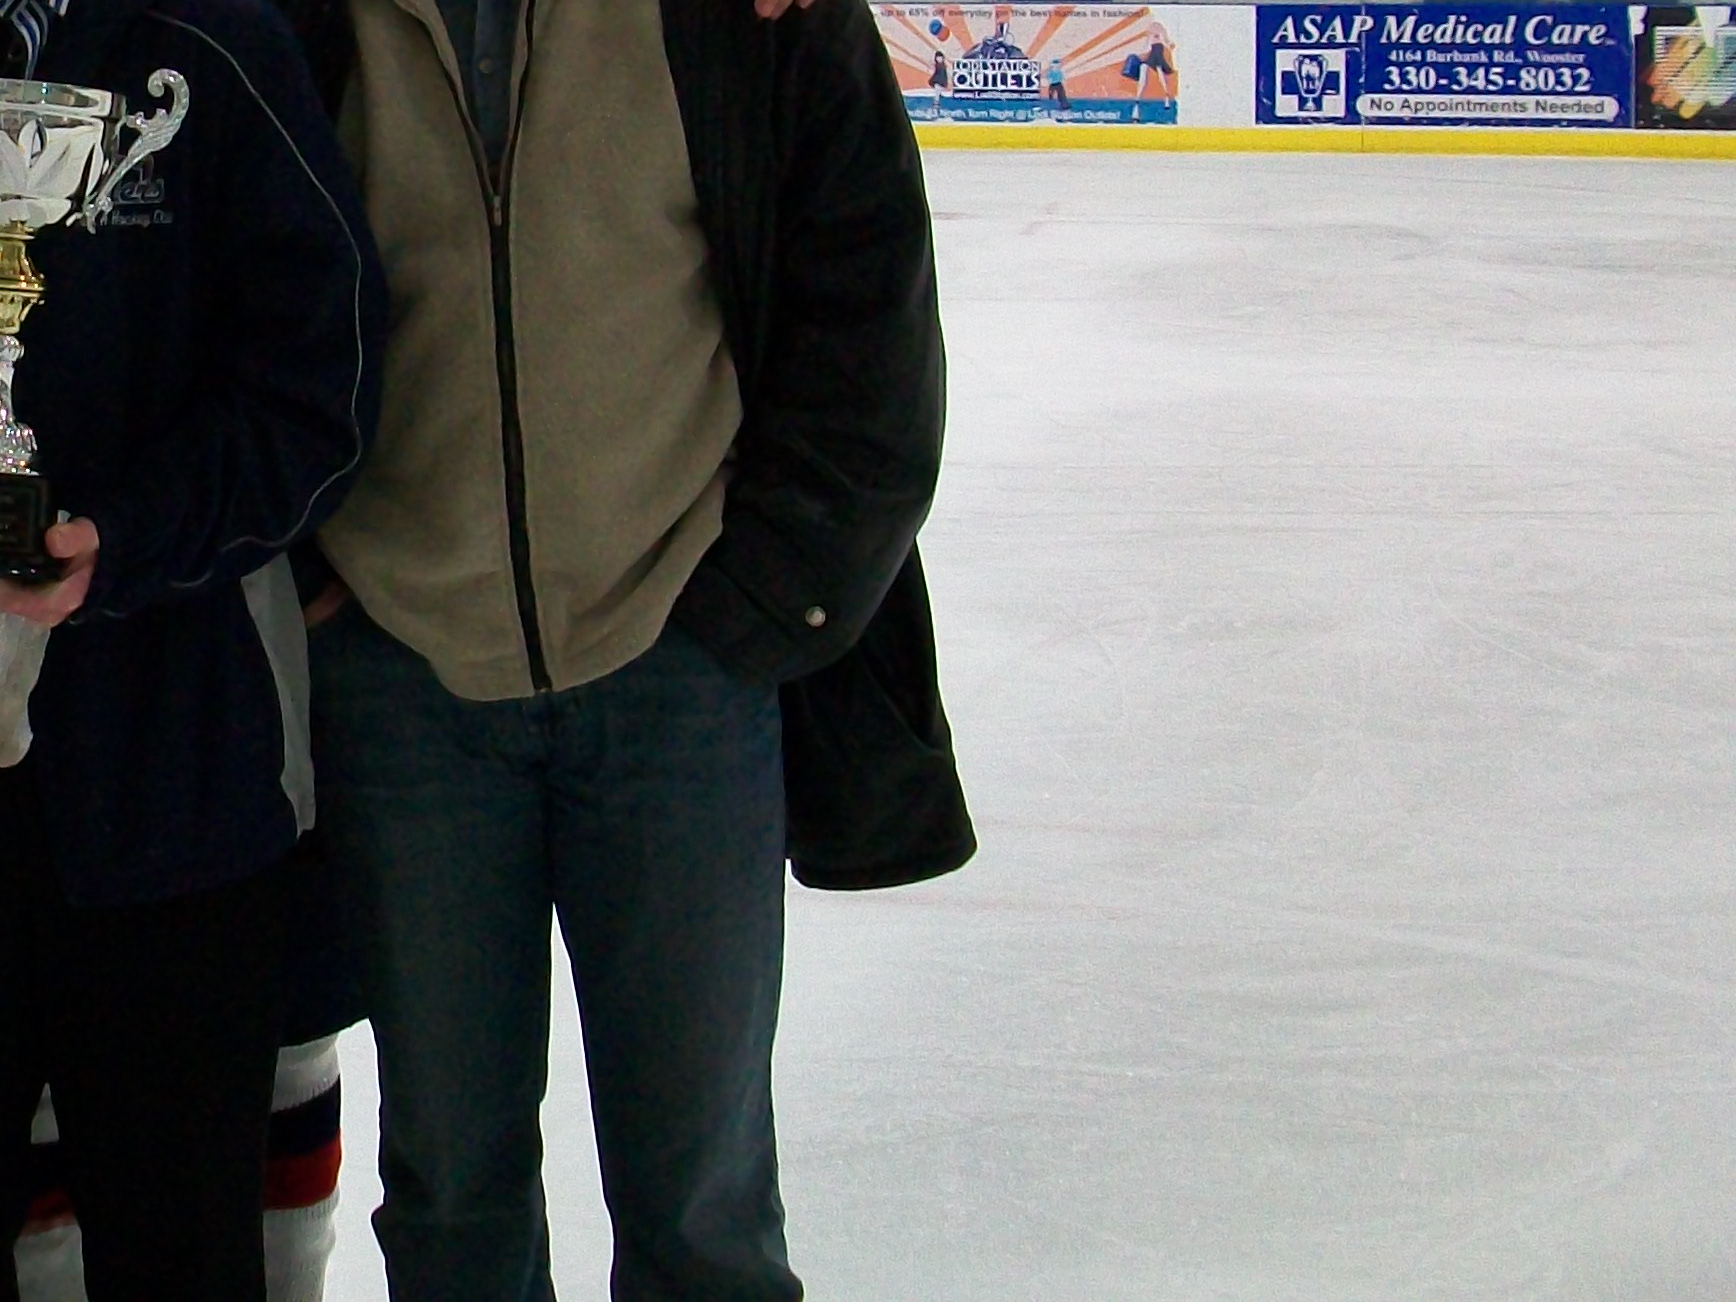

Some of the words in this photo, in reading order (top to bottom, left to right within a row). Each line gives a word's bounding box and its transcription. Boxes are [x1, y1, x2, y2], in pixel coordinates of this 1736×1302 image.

[909, 7, 930, 16] 65%
[948, 8, 993, 18] everyday
[1011, 8, 1028, 17] the
[1030, 8, 1051, 17] best
[1091, 9, 1100, 18] in
[1272, 15, 1374, 45] ASAP
[1381, 14, 1520, 45] Medical
[1525, 14, 1606, 45] Care
[1388, 50, 1422, 62] 4164
[1426, 49, 1489, 63] Burbank
[1527, 50, 1586, 63] Wooster
[986, 60, 1040, 72] STATION
[953, 71, 1040, 88] OUTLETS
[1384, 65, 1592, 92] 330-345-8032
[1368, 98, 1395, 113] No
[1400, 97, 1529, 116] Appointments
[1534, 99, 1606, 114] Needed
